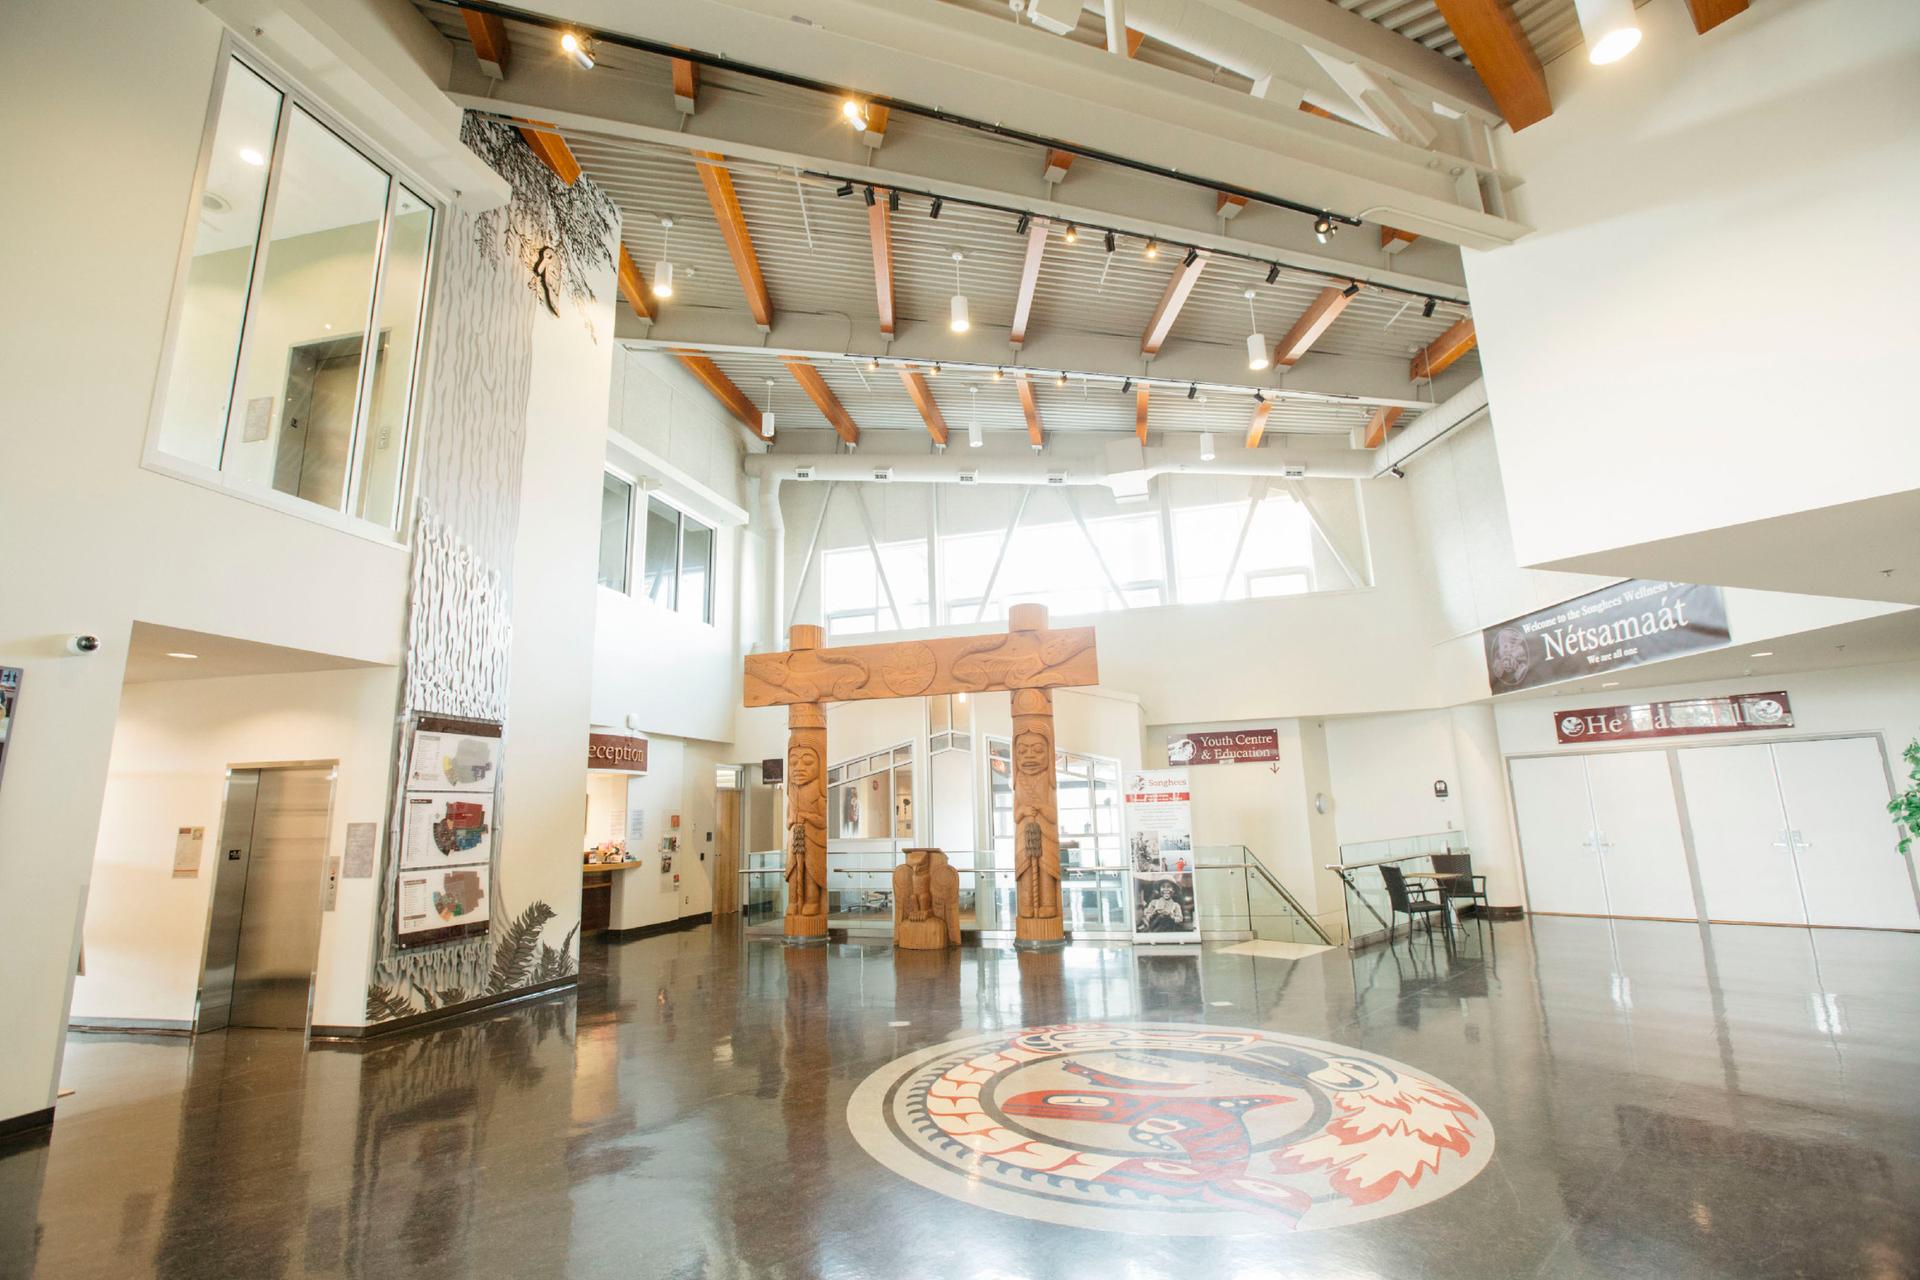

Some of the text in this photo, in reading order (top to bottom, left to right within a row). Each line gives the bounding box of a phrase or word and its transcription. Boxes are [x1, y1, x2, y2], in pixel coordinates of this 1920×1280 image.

[1522, 617, 1557, 634] Welcome
[1557, 614, 1567, 624] to
[1567, 609, 1581, 621] the
[1581, 597, 1623, 616] Songhees
[1623, 581, 1668, 602] Wellness
[1541, 596, 1689, 661] Nétsamaát
[1587, 654, 1600, 665] We
[1200, 734, 1273, 747] Youth Centre
[1201, 747, 1271, 760] & Education
